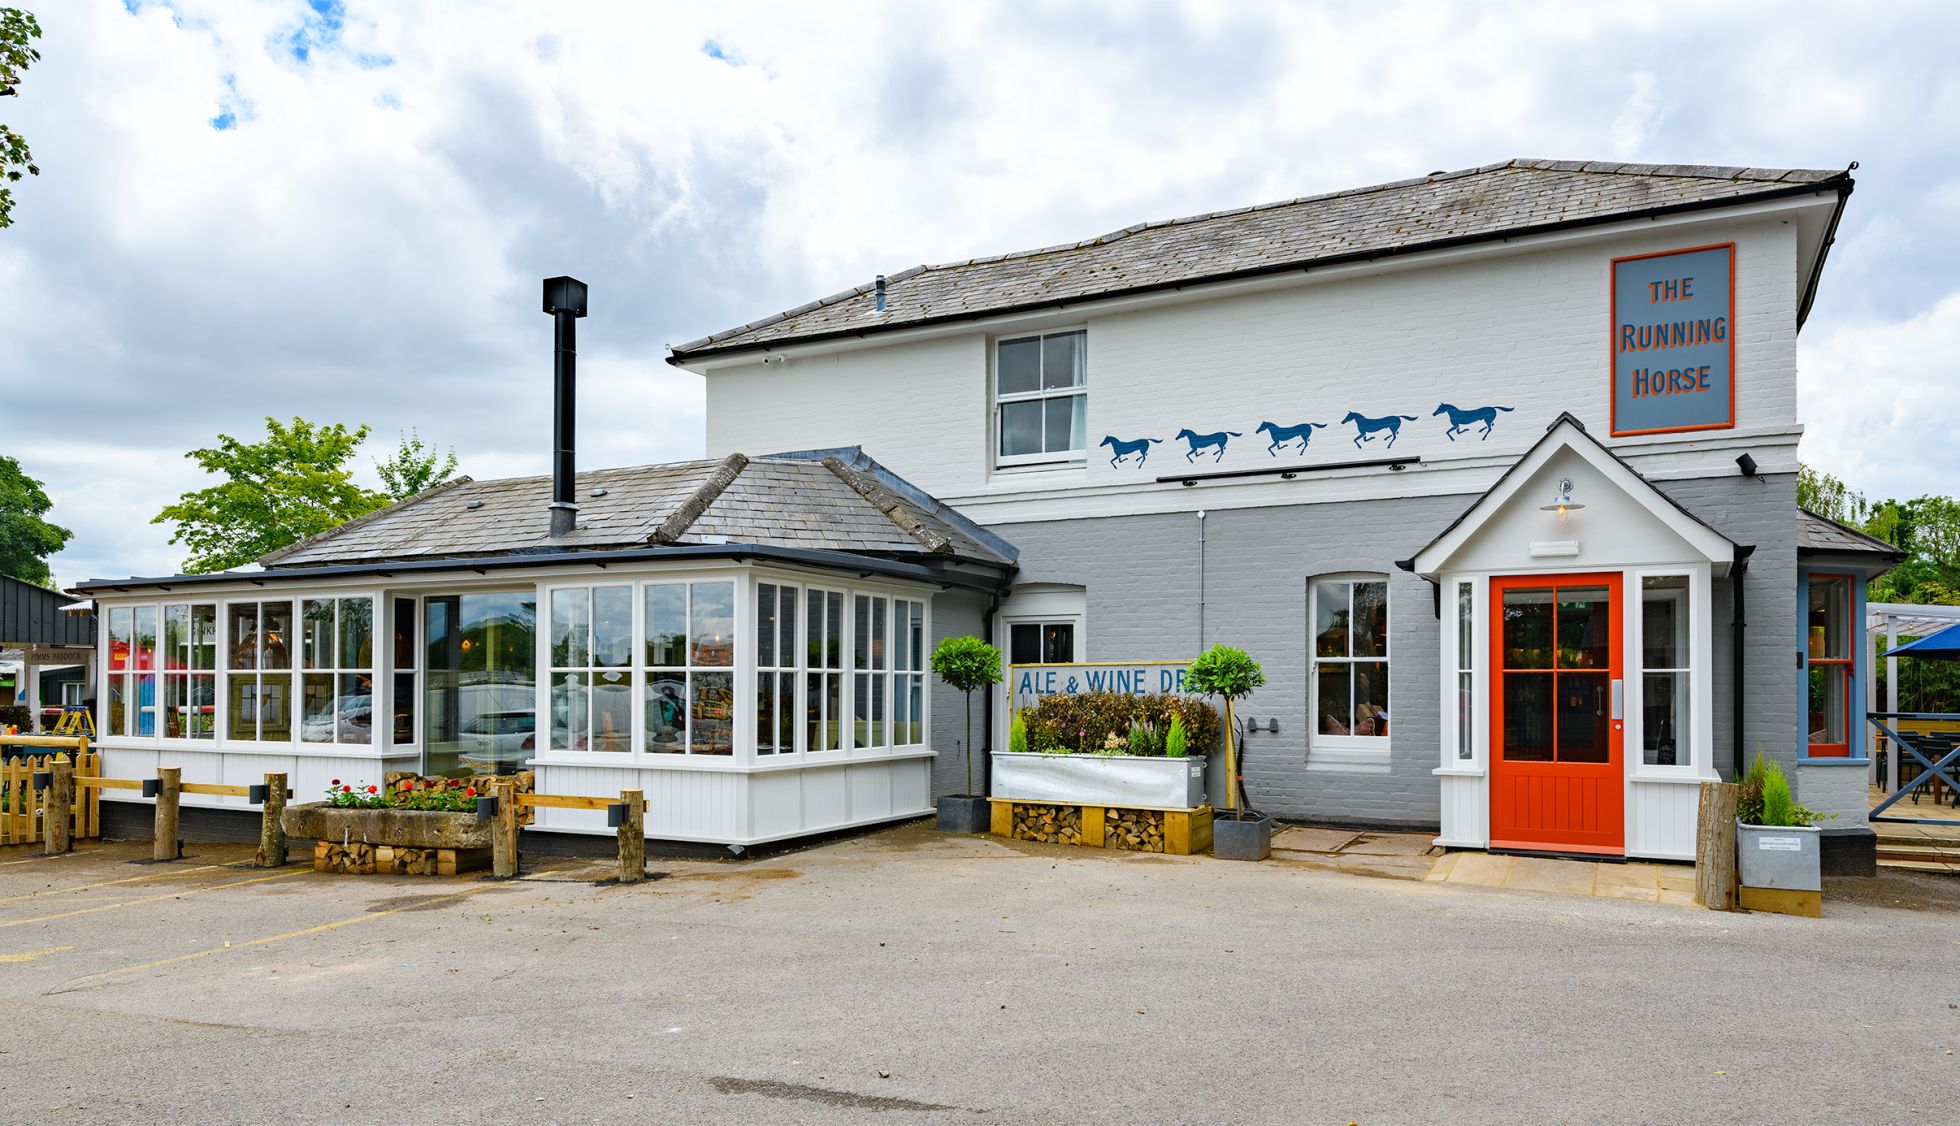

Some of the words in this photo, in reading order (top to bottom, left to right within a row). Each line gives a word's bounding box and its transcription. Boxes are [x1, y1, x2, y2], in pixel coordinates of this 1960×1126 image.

[1648, 277, 1694, 304] THE
[1619, 317, 1726, 353] RUNNING
[1632, 366, 1711, 399] HORSE
[52, 651, 81, 661] PADDOCK
[1019, 671, 1057, 694] ALE
[1066, 675, 1079, 694] &
[1085, 670, 1146, 694] WINE
[1160, 669, 1194, 694] DR
